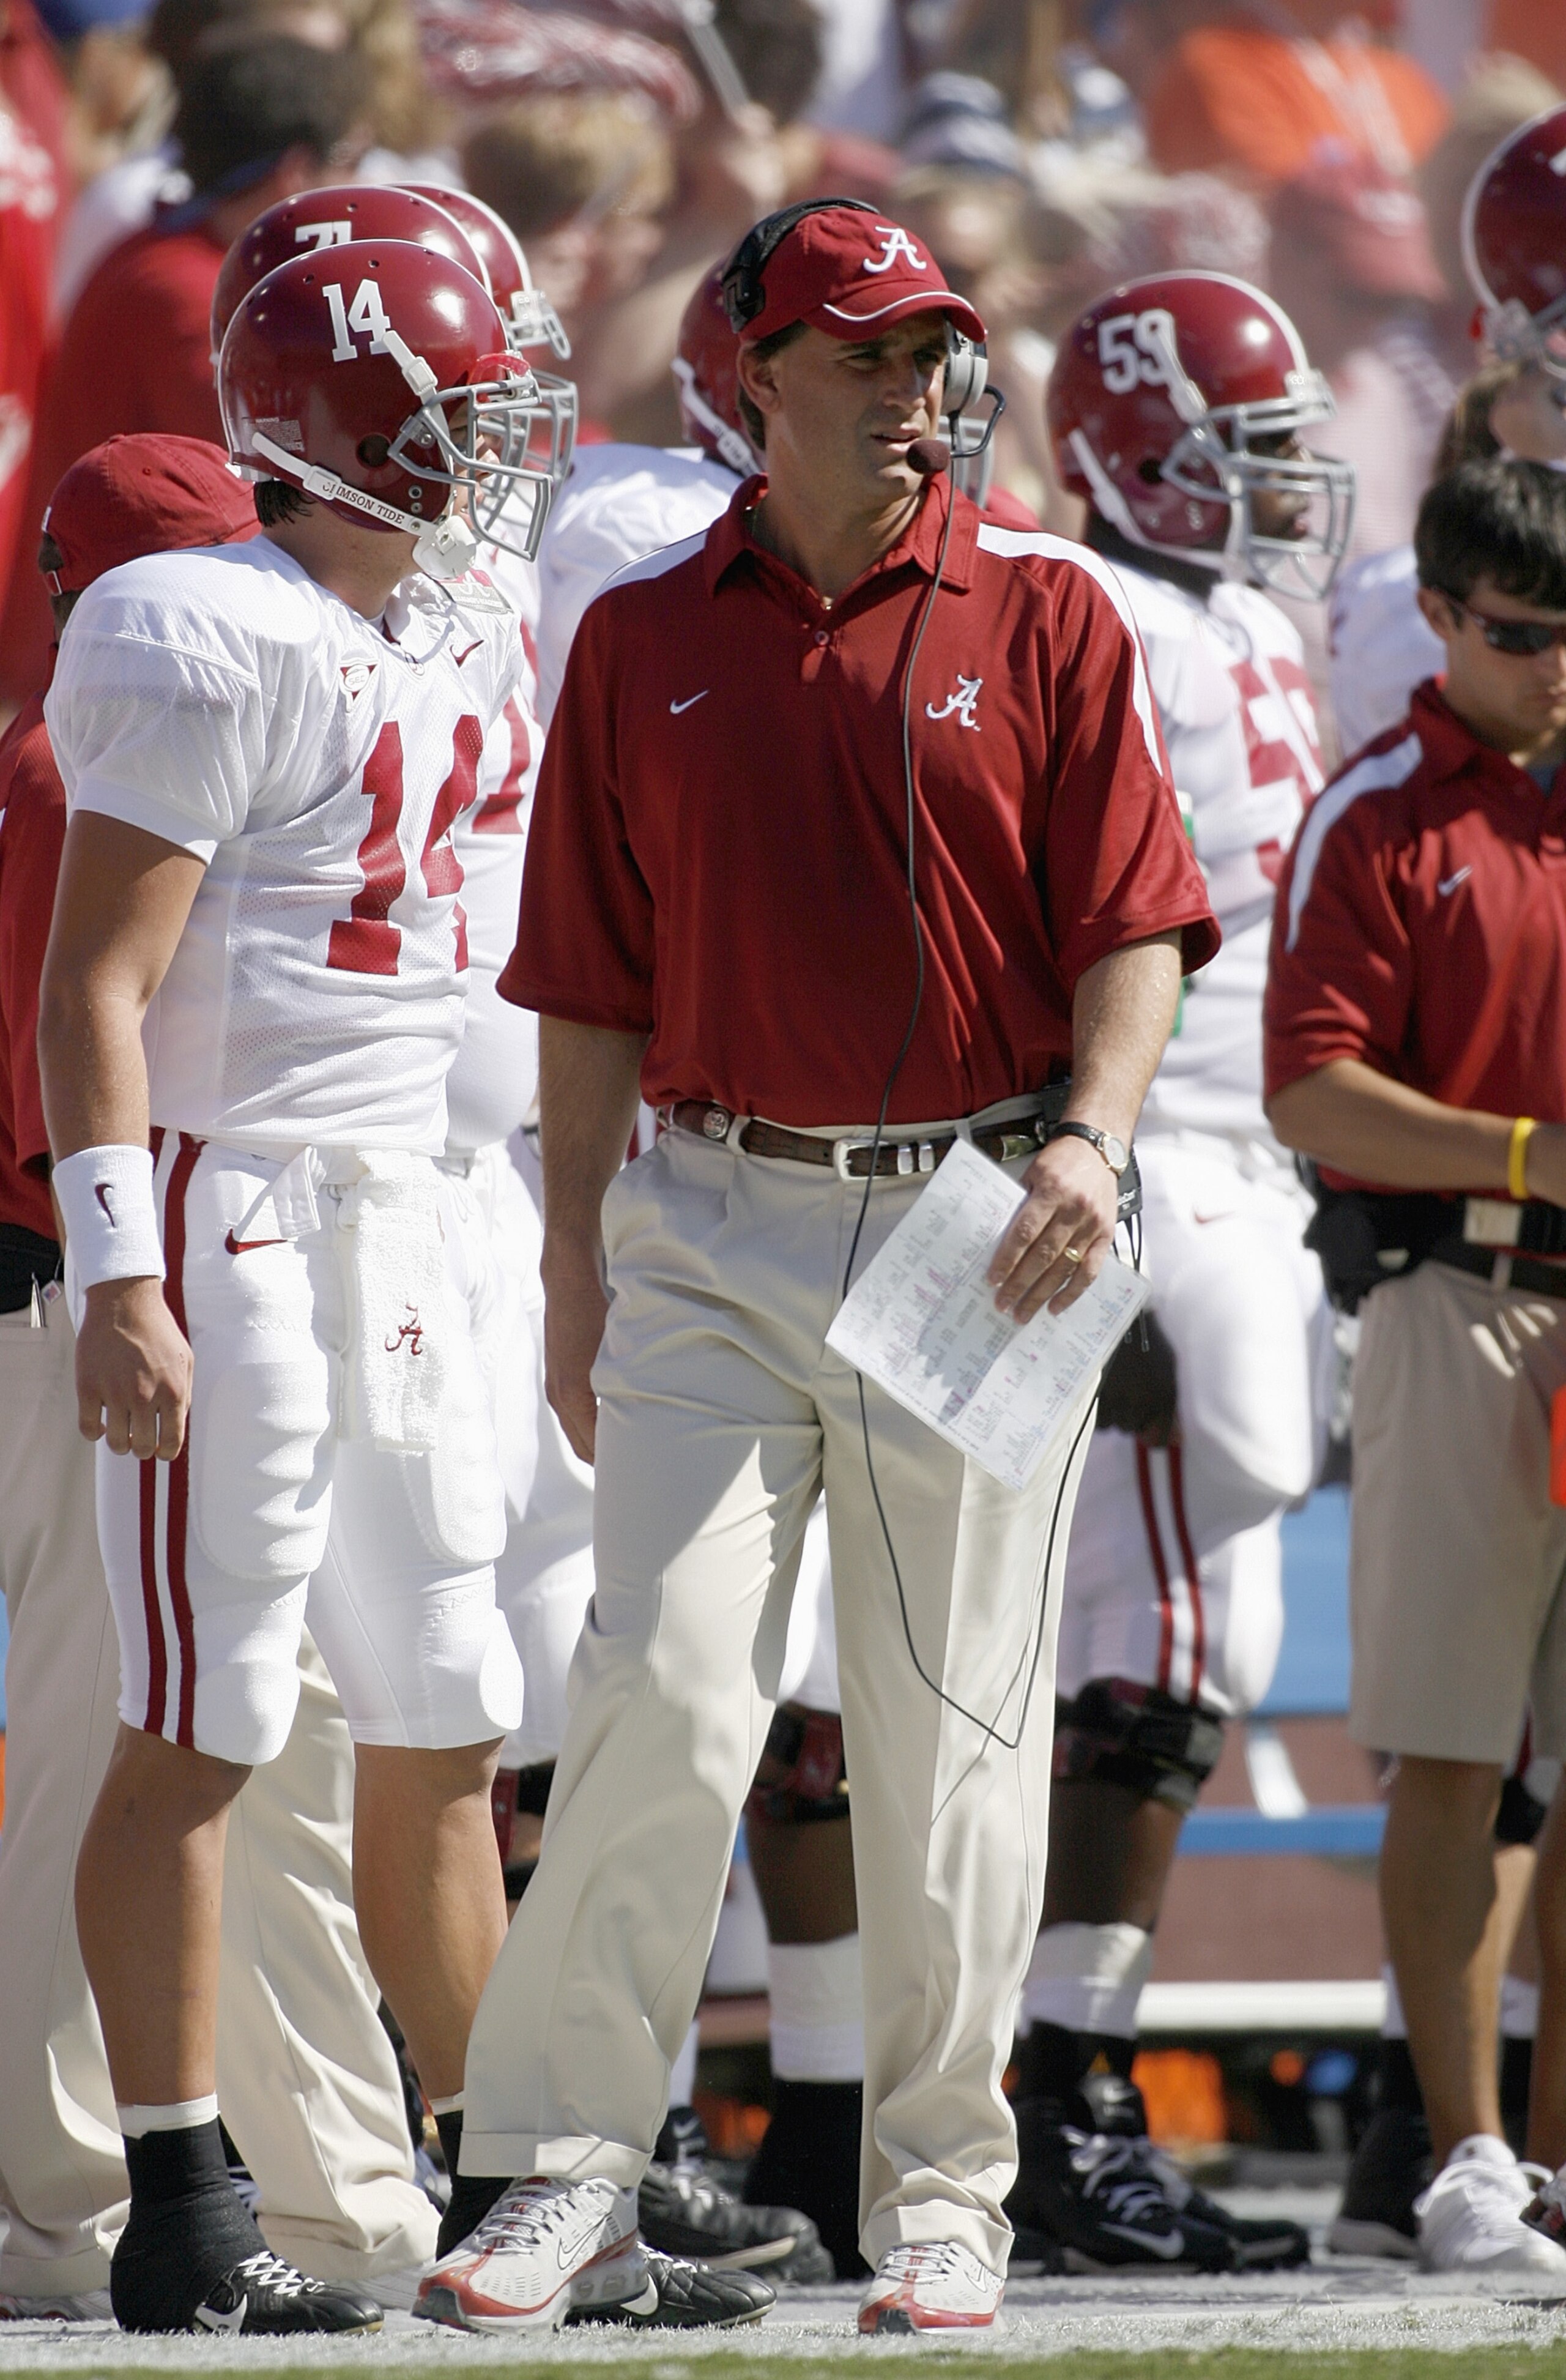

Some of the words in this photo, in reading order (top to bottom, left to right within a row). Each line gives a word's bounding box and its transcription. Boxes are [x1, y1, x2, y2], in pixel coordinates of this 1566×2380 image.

[863, 225, 927, 273] A
[322, 278, 391, 362] 14
[1099, 308, 1176, 393] 59
[377, 504, 405, 524] TIDE
[349, 675, 366, 685] SEC
[926, 674, 983, 728] A
